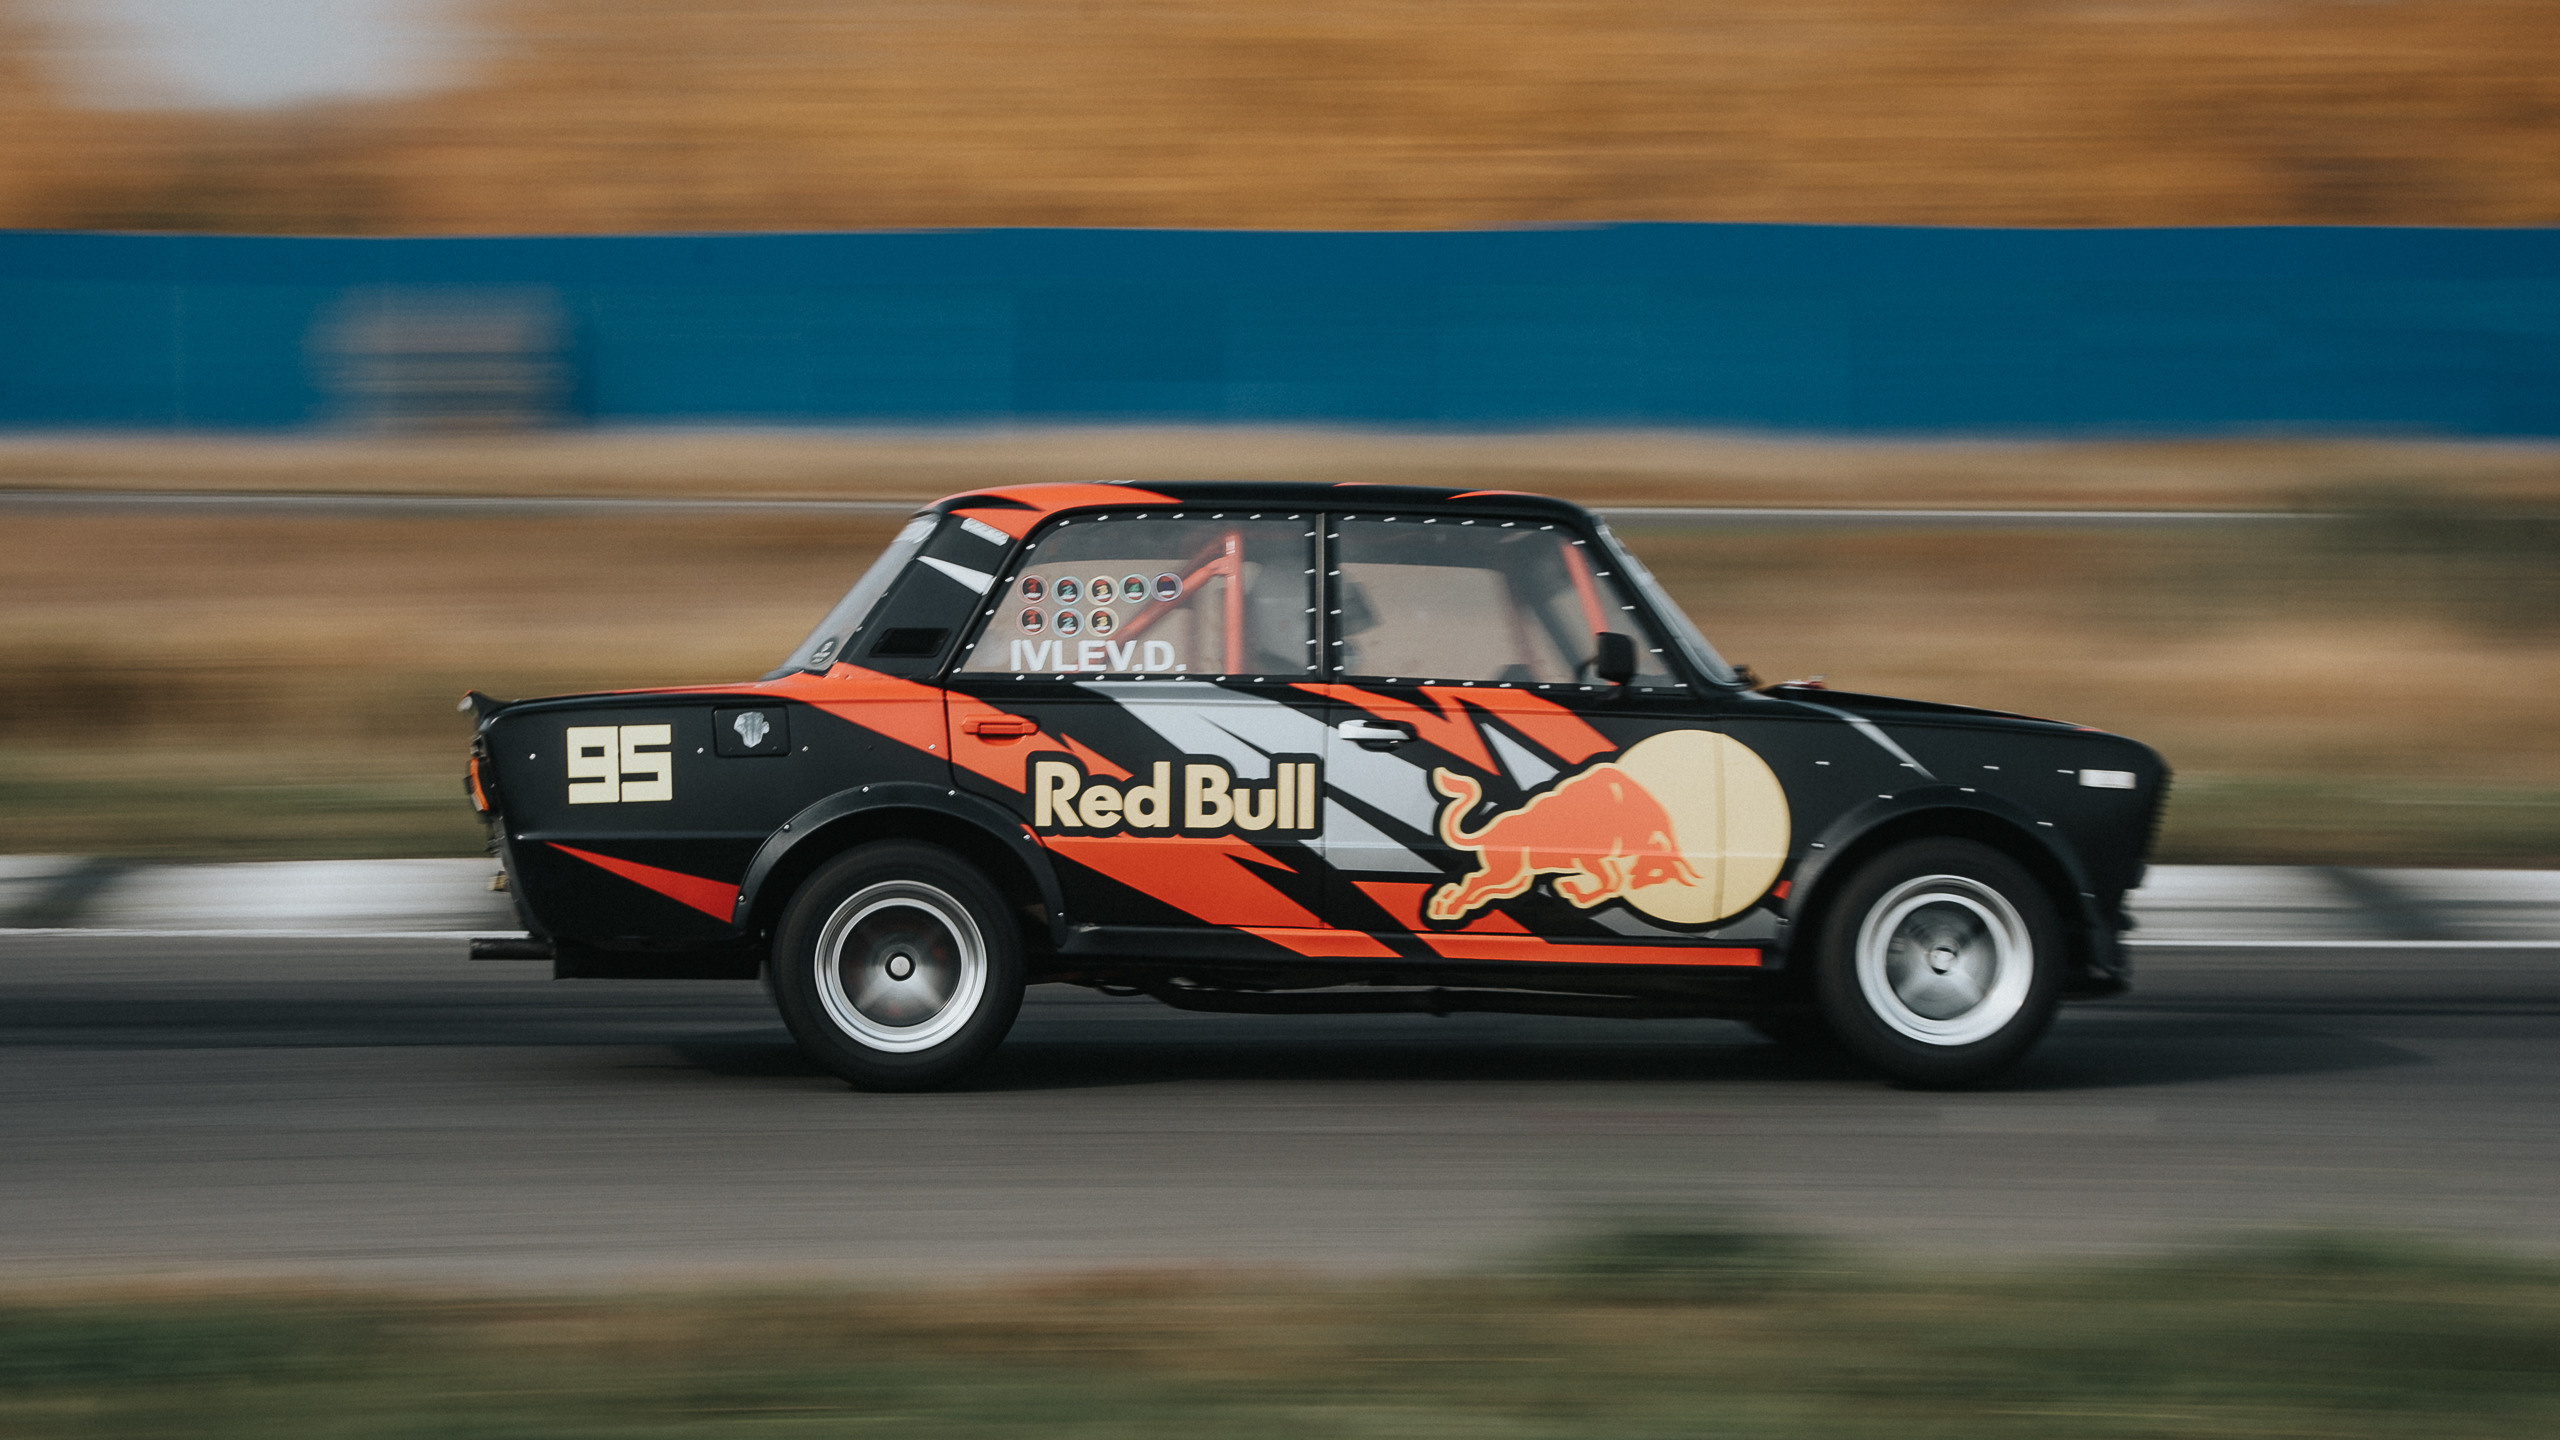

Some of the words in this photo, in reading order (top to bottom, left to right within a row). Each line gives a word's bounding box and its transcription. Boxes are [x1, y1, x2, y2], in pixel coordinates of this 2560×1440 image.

[1010, 639, 1187, 672] IVLEV.D.
[566, 724, 672, 804] 95
[1035, 761, 1171, 829] Red
[1185, 763, 1316, 831] Bull
